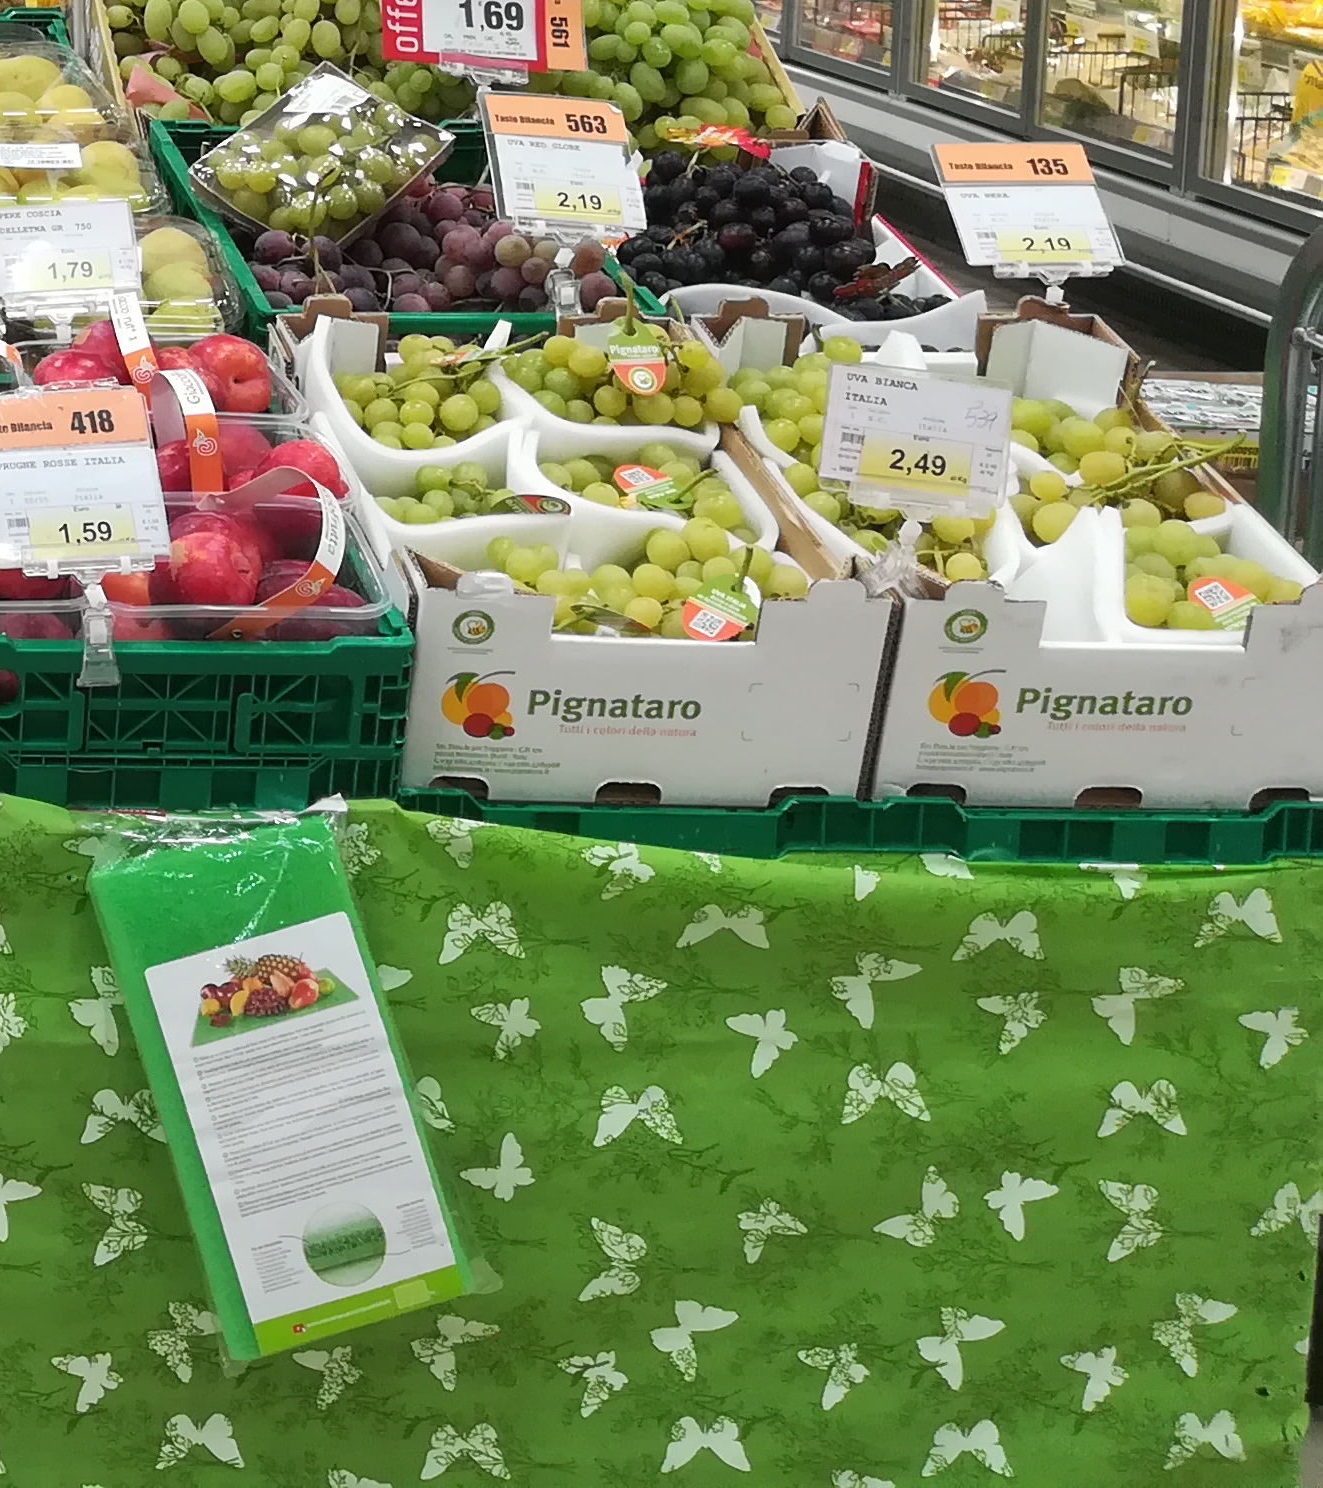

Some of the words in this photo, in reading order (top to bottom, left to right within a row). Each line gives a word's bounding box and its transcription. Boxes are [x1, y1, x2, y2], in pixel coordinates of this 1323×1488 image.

[550, 15, 568, 50] 561
[565, 114, 608, 135] 563
[1025, 157, 1070, 176] 135
[556, 192, 603, 212] 2,19
[26, 210, 63, 219] COSCIA
[1021, 235, 1072, 255] 2,19
[46, 261, 94, 282] 1,79
[609, 344, 660, 358] Pignataro
[846, 372, 870, 386] UVA
[874, 377, 919, 392] BIANCA
[844, 391, 888, 407] ITALIA
[10, 420, 54, 434] Bilancia
[69, 409, 116, 435] 418
[42, 458, 79, 468] ROSSE
[83, 456, 126, 467] ITALIA
[888, 448, 948, 477] 2,49
[57, 520, 113, 546] 1,59
[526, 688, 703, 722] Pignataro
[1015, 686, 1194, 720] Pignataro
[593, 724, 622, 736] colori
[625, 724, 657, 737] della
[659, 726, 698, 738] natura
